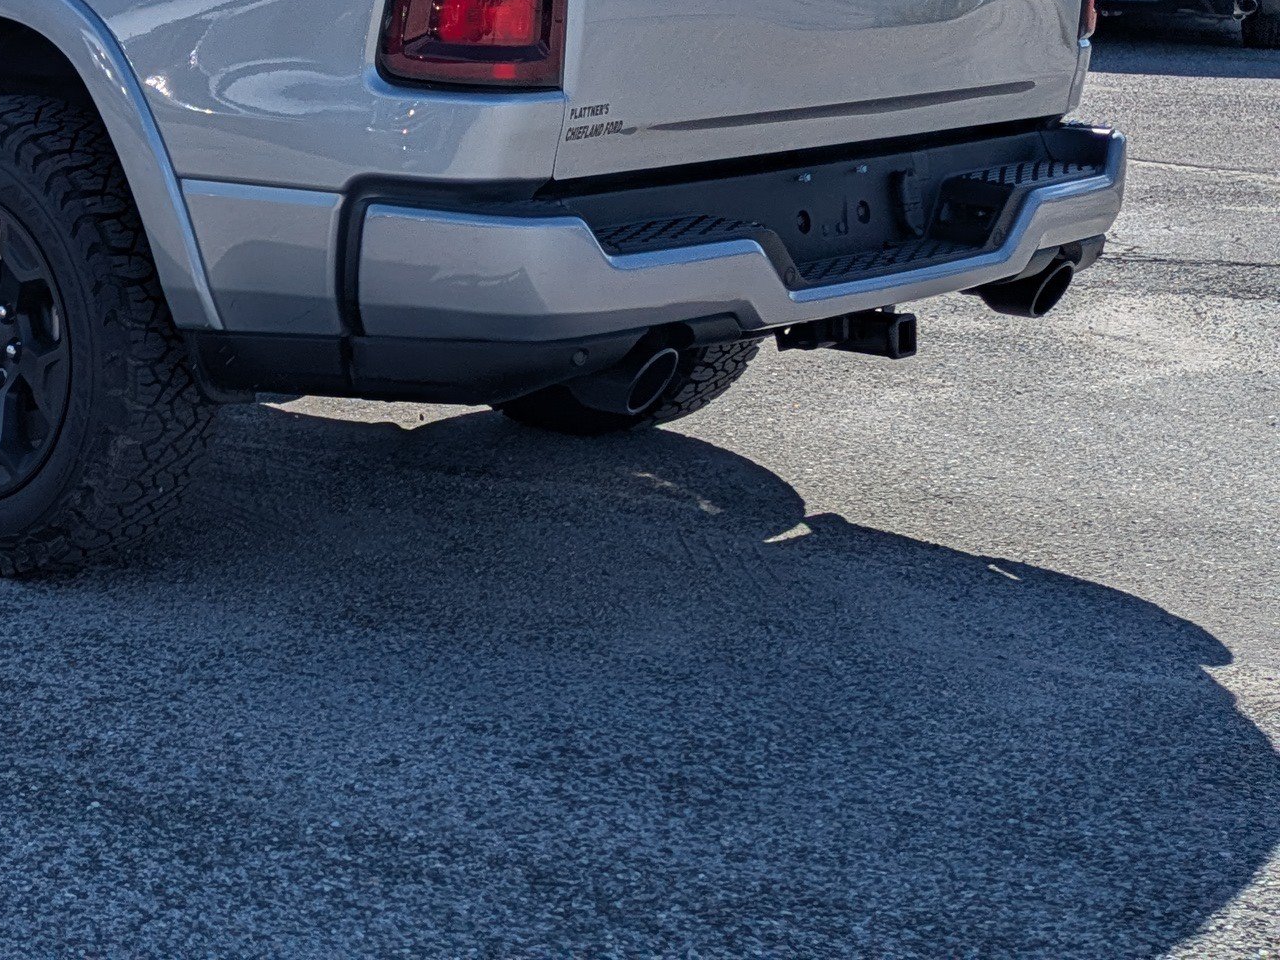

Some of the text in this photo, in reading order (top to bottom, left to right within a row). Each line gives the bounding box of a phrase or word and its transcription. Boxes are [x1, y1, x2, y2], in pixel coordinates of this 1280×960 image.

[569, 103, 610, 120] PLATTNER'S
[565, 120, 624, 141] CHIEFLAND FORD
